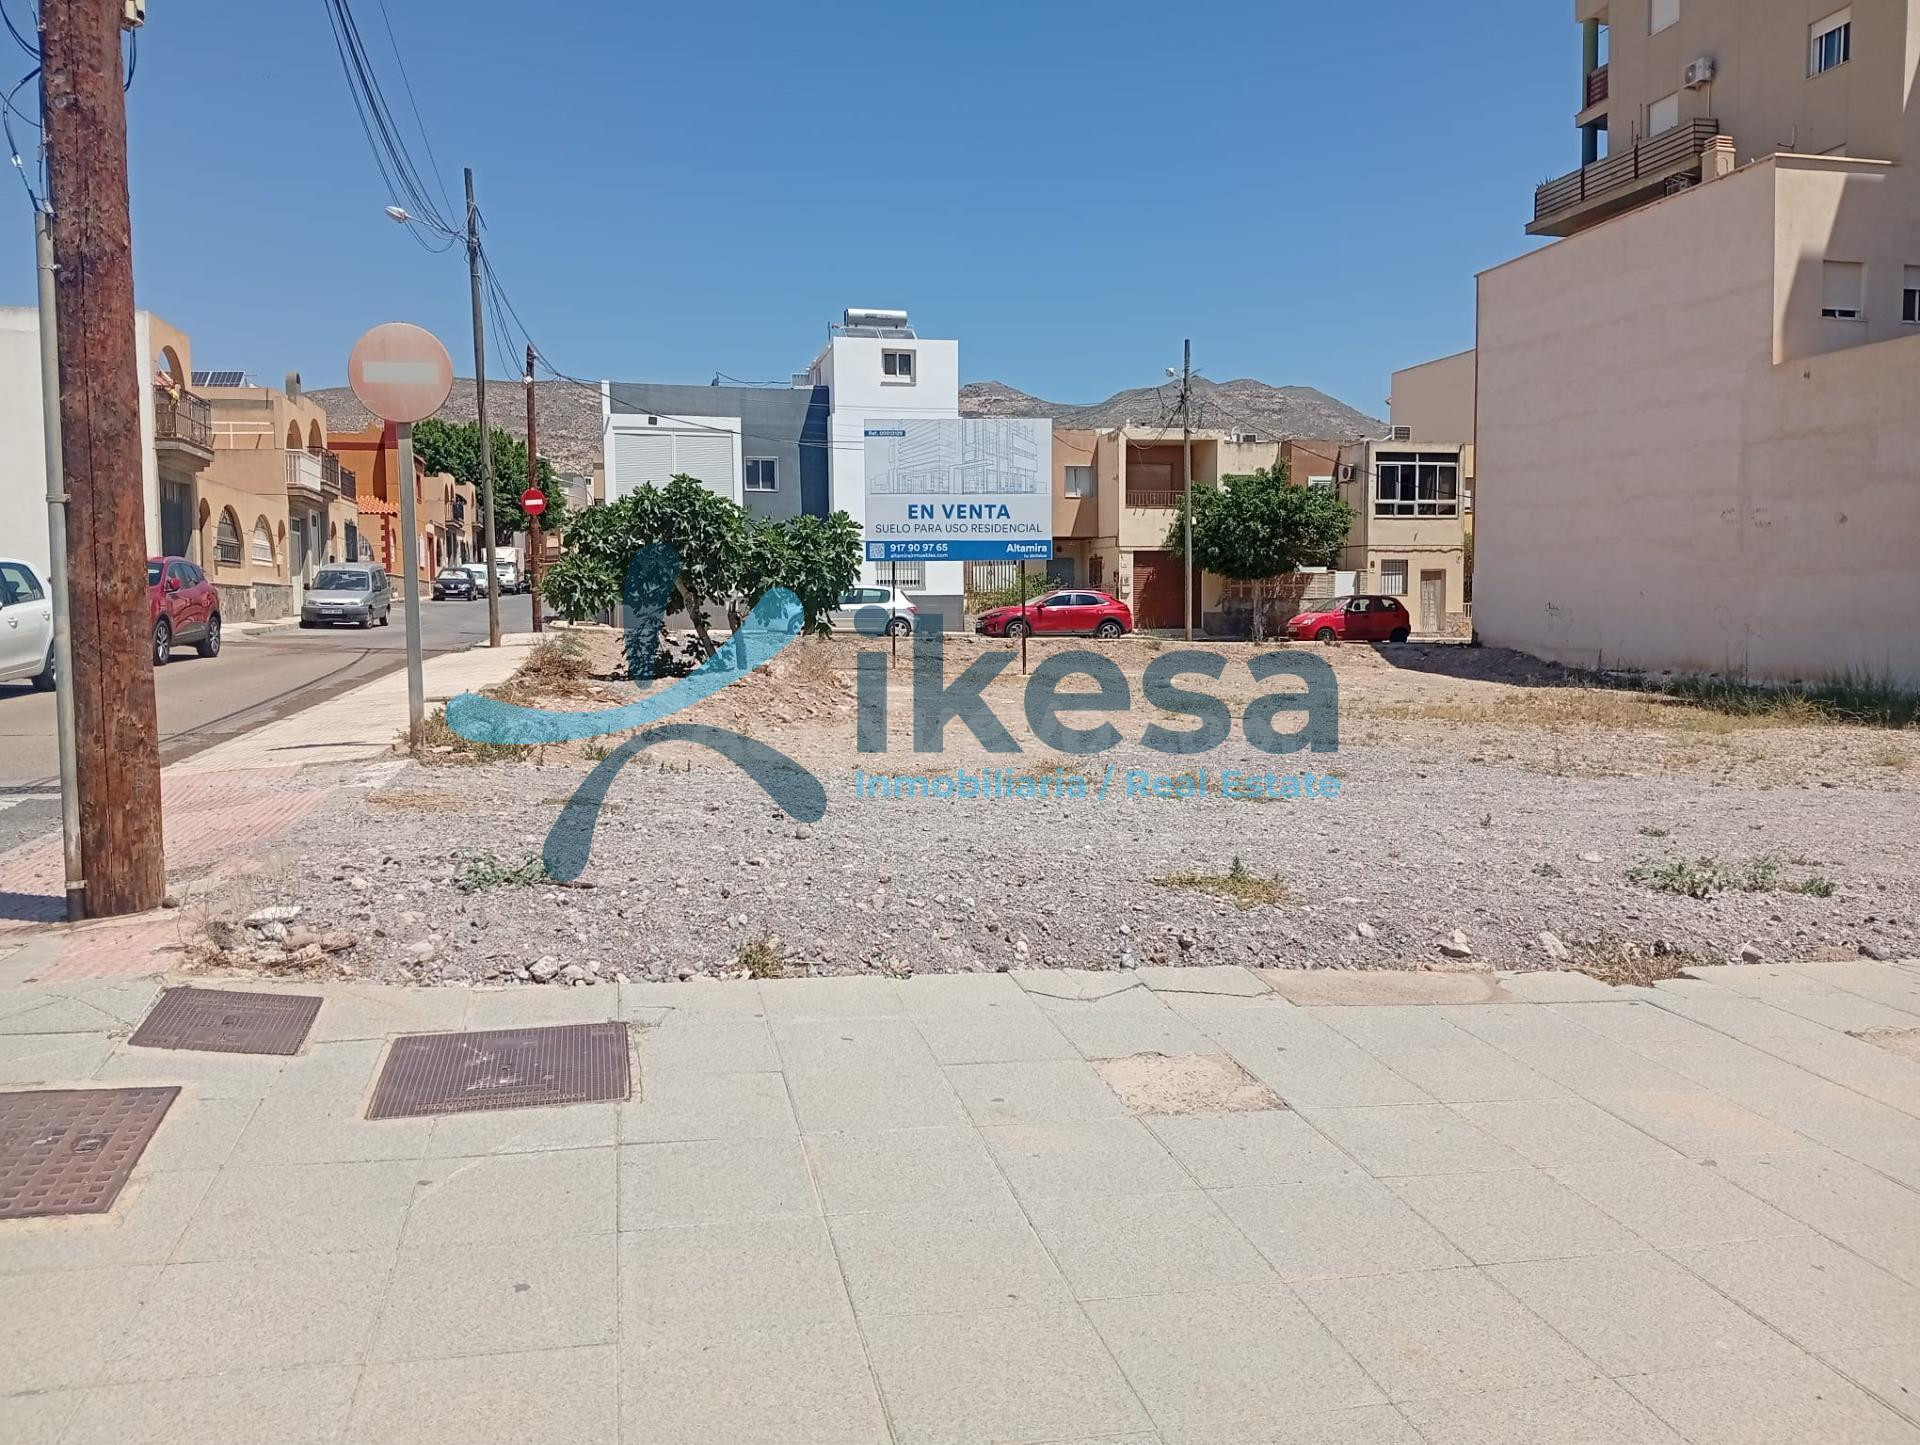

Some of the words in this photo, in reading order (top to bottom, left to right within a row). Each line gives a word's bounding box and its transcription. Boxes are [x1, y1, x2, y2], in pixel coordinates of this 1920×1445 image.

[908, 504, 934, 519] EN
[942, 504, 1010, 519] VENTA
[875, 523, 911, 534] SUELO
[914, 523, 942, 533] PARA
[945, 523, 968, 533] USO
[971, 523, 1043, 533] RESIDENCIAL
[890, 543, 906, 552] 917
[907, 543, 920, 552] 90
[922, 543, 934, 552] 97
[936, 543, 948, 552] 65
[1006, 543, 1047, 553] Altamira
